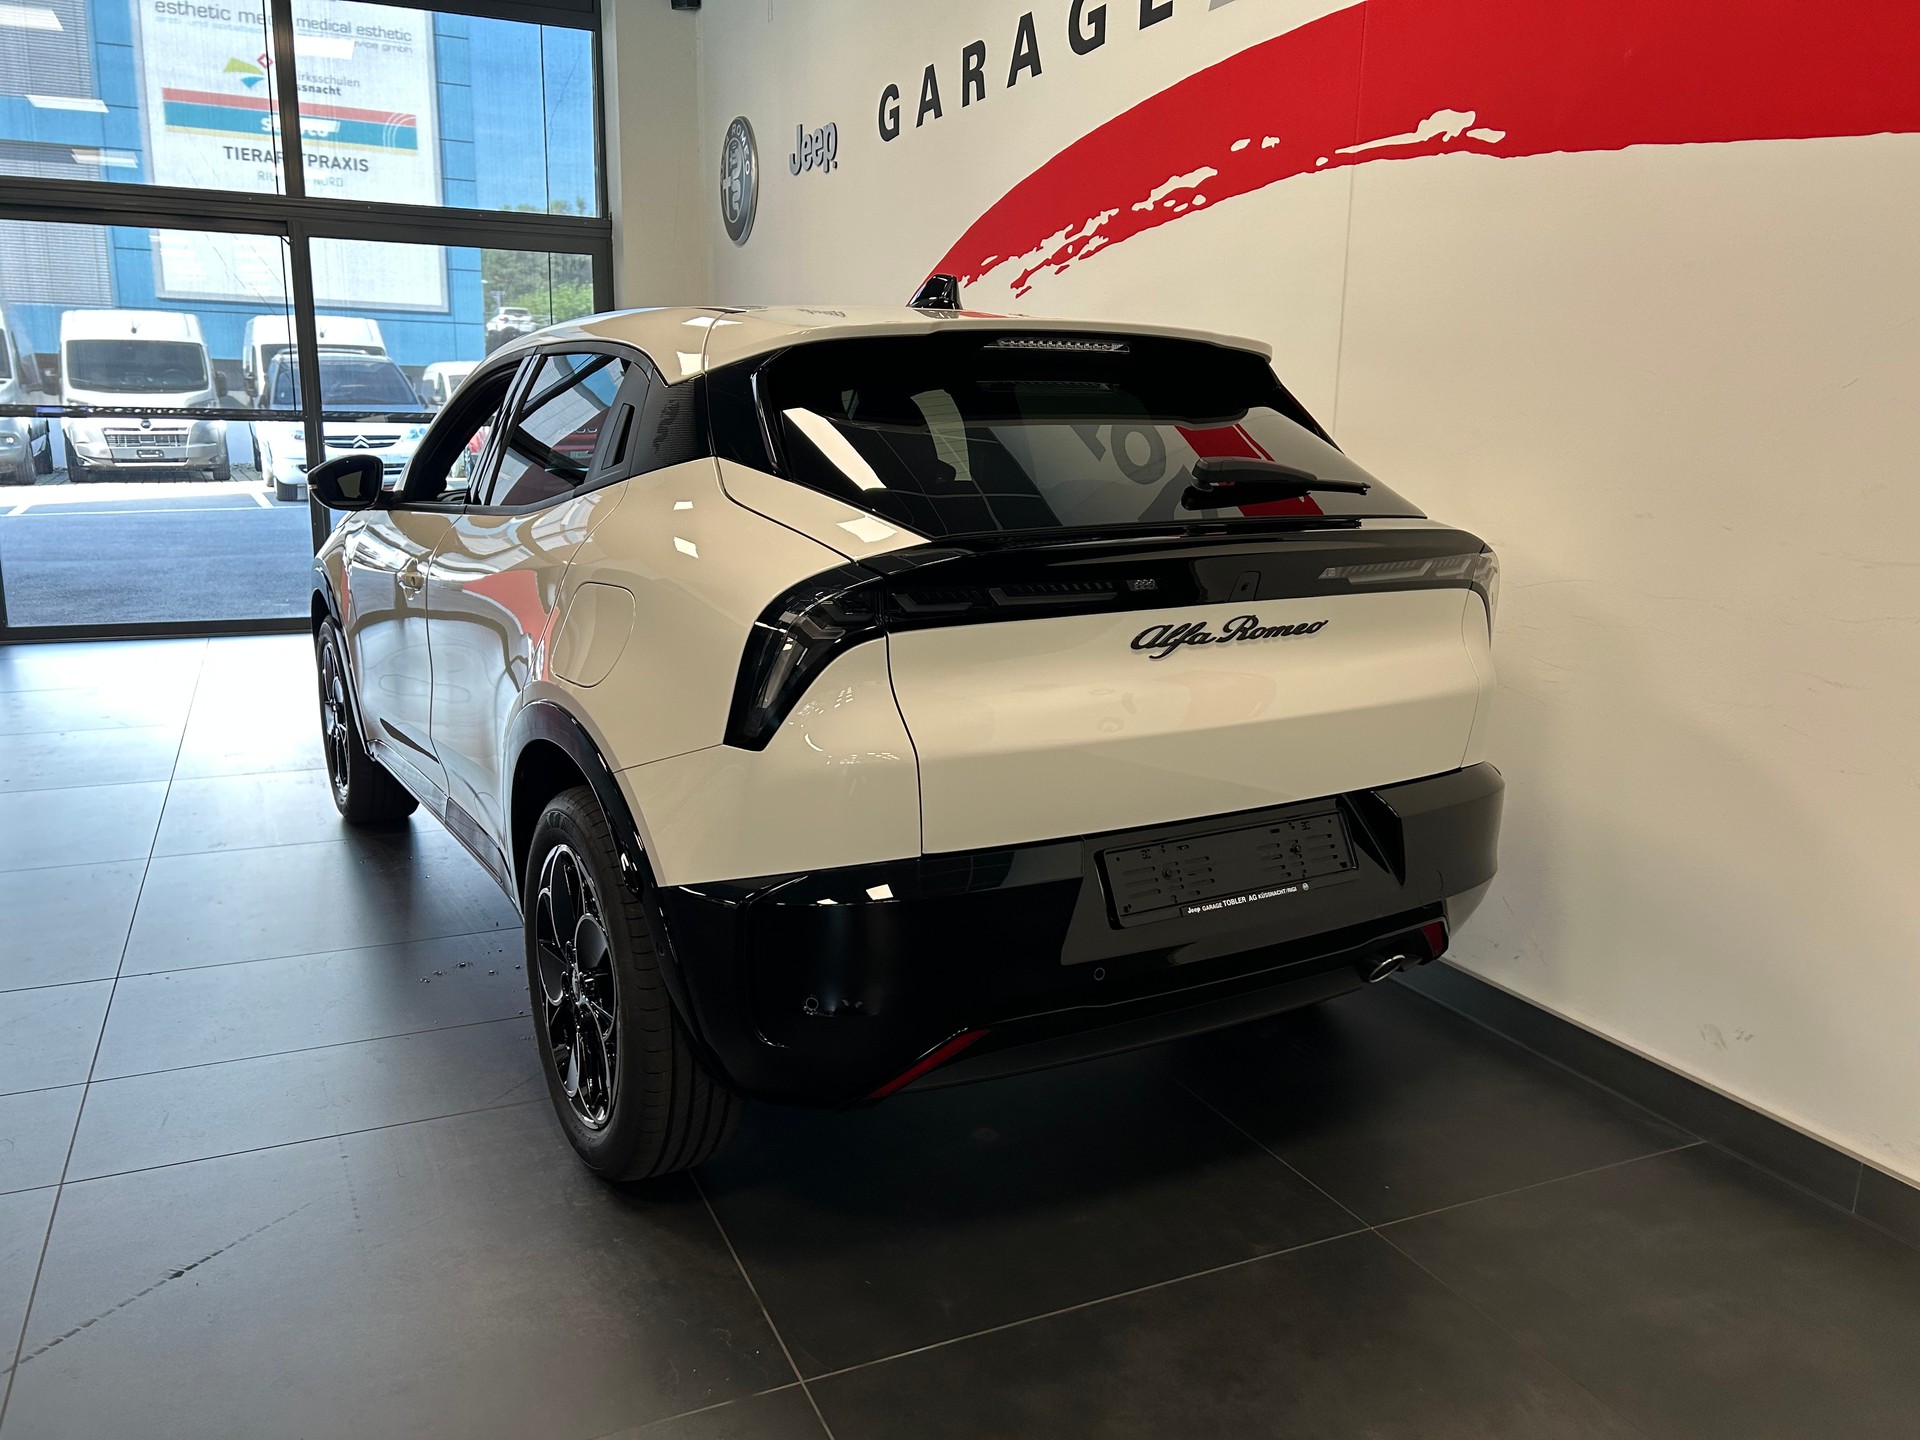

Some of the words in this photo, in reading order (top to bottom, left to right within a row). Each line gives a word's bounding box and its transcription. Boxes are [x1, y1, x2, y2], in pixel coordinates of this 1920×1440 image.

[154, 0, 231, 21] esthetic
[296, 17, 352, 34] medical
[356, 24, 412, 41] esthetic
[1130, 620, 1218, 660] Alfa
[1215, 614, 1329, 643] Romeo
[1201, 902, 1223, 911] GARAGE
[1222, 896, 1247, 907] TOBLER
[1248, 894, 1258, 902] AG
